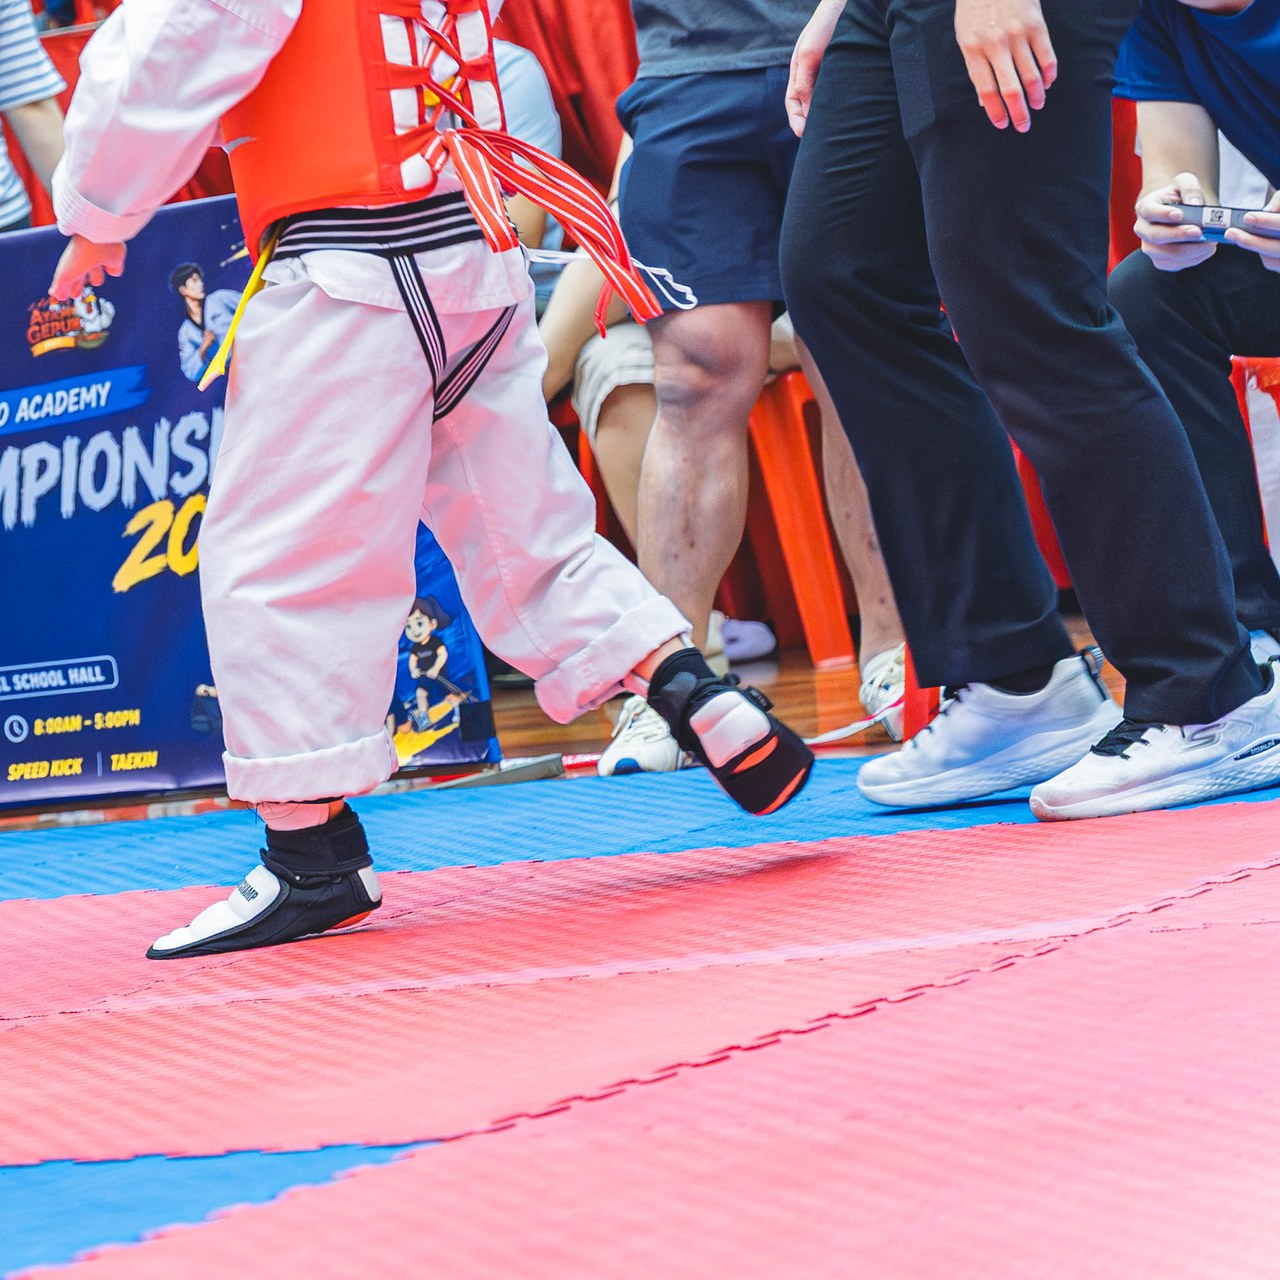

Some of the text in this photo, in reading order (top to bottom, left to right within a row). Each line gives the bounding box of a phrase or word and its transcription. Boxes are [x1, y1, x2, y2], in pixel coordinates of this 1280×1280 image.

[15, 381, 111, 423] ACADEMY
[112, 493, 208, 593] 20
[13, 669, 67, 692] SCHOOL
[68, 665, 105, 686] HALL
[7, 759, 50, 782] SPEED
[50, 757, 84, 778] KICK
